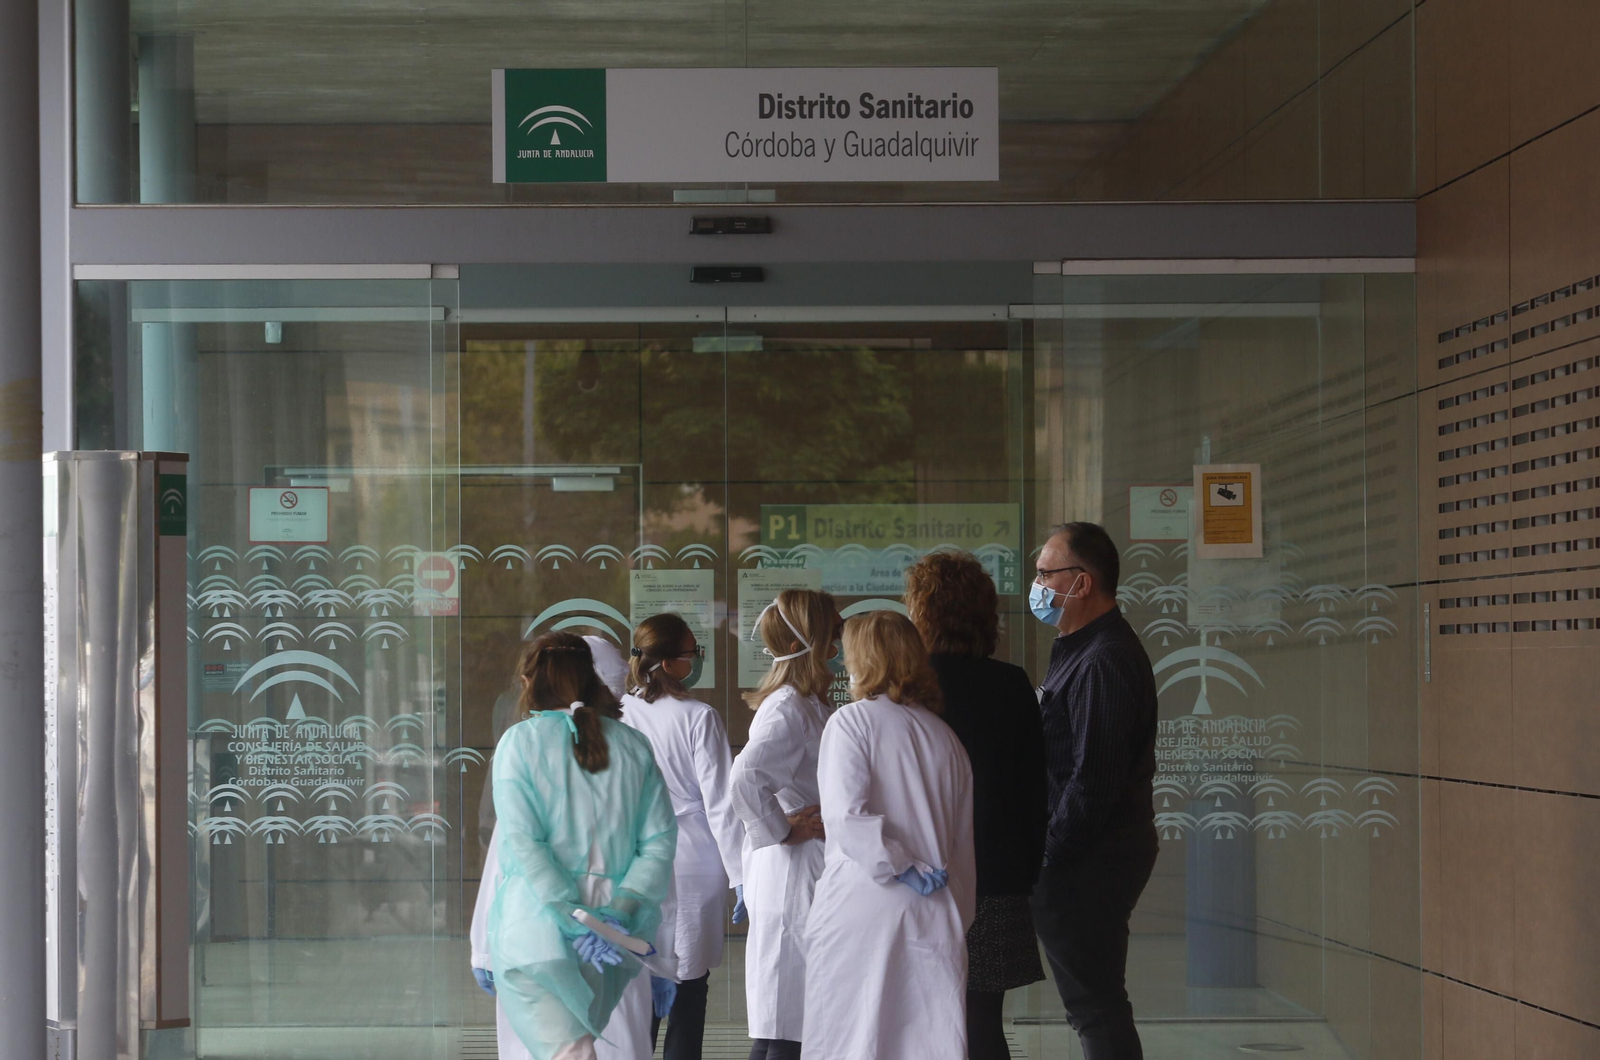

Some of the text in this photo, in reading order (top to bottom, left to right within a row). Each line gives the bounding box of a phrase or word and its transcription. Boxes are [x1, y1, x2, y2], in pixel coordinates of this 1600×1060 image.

[759, 92, 974, 119] Distrito Sanitario
[725, 130, 979, 163] Córdoba y Guadalquivir
[517, 149, 541, 159] JUNTA
[543, 149, 553, 159] DE
[769, 514, 801, 540] P1
[814, 516, 983, 540] Distrito Sanitario
[871, 566, 902, 577] Área de
[1004, 567, 1014, 577] P2
[231, 724, 269, 739] JUNTA
[275, 724, 290, 739] DE
[1181, 719, 1196, 734] DE
[227, 740, 366, 752] CONSEJERÍA DE SALUD
[1155, 735, 1272, 748] NSEJERÍA DE SALUD
[235, 754, 358, 765] Y BIENESTAR SOCIAL
[1221, 748, 1265, 759] SOCIAL
[248, 765, 345, 776] Distrito Sanitario
[1158, 762, 1254, 772] Distrito Sanitario
[228, 776, 278, 787] Córdoba
[290, 776, 365, 787] Guadalquivir
[1153, 773, 1274, 786] rdoba y Guadalquivir
